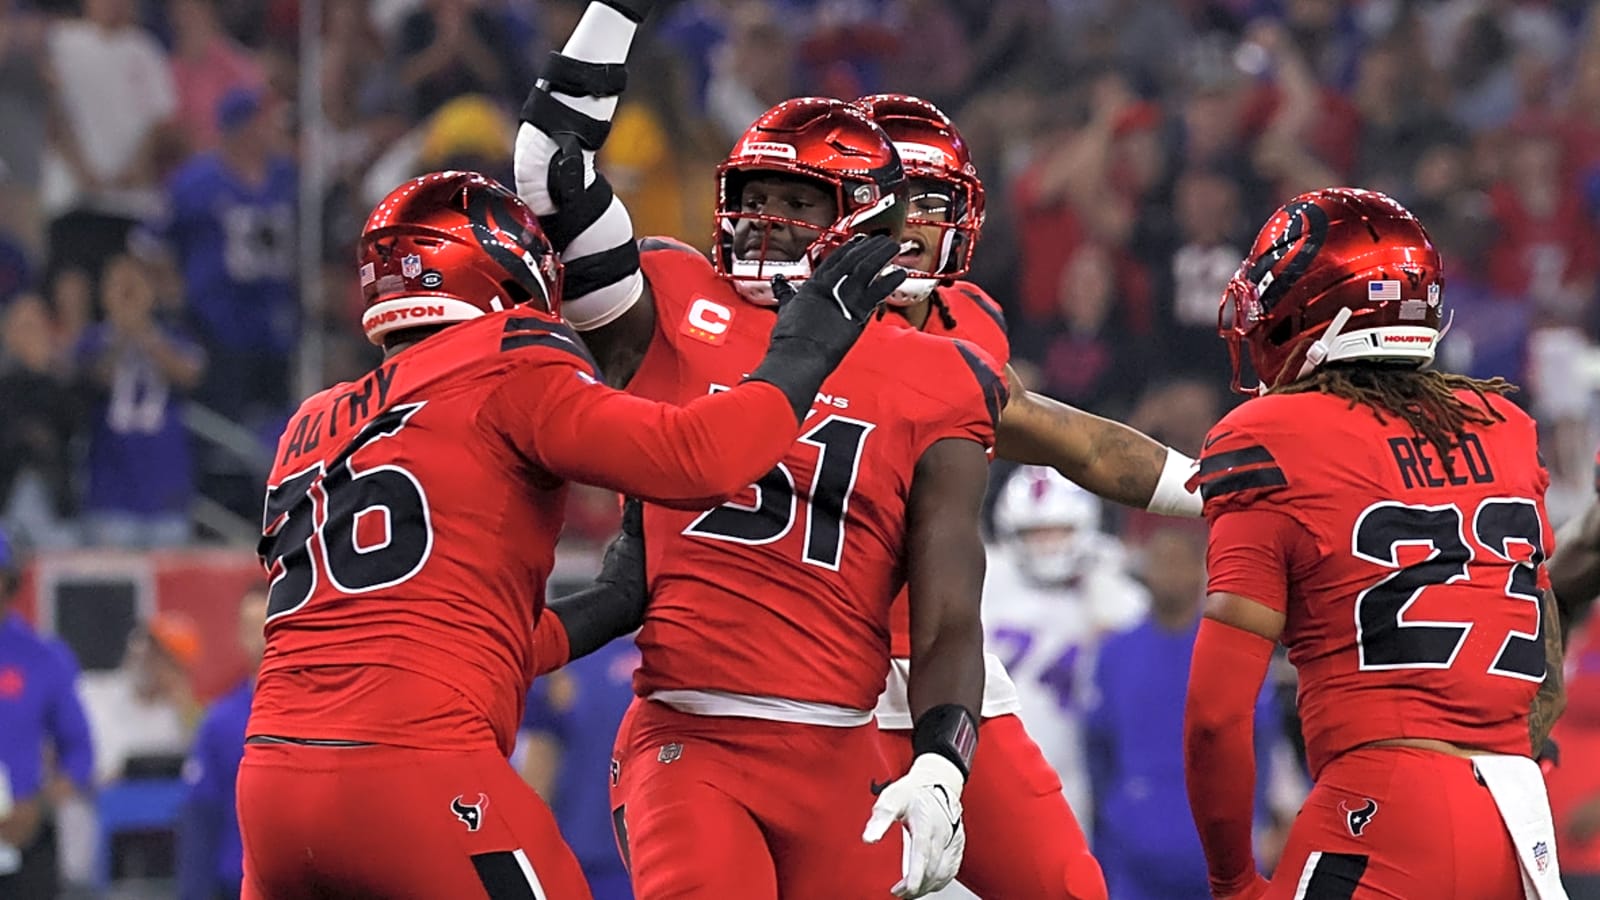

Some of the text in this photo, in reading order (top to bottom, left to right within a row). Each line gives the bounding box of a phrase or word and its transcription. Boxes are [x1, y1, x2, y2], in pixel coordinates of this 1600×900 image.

[748, 144, 789, 153] TEXANS
[365, 305, 445, 332] OUSTON
[688, 298, 731, 335] C
[1384, 335, 1432, 343] HOUSTON
[256, 400, 434, 625] 96
[1351, 496, 1548, 684] 23
[992, 625, 1080, 709] 74
